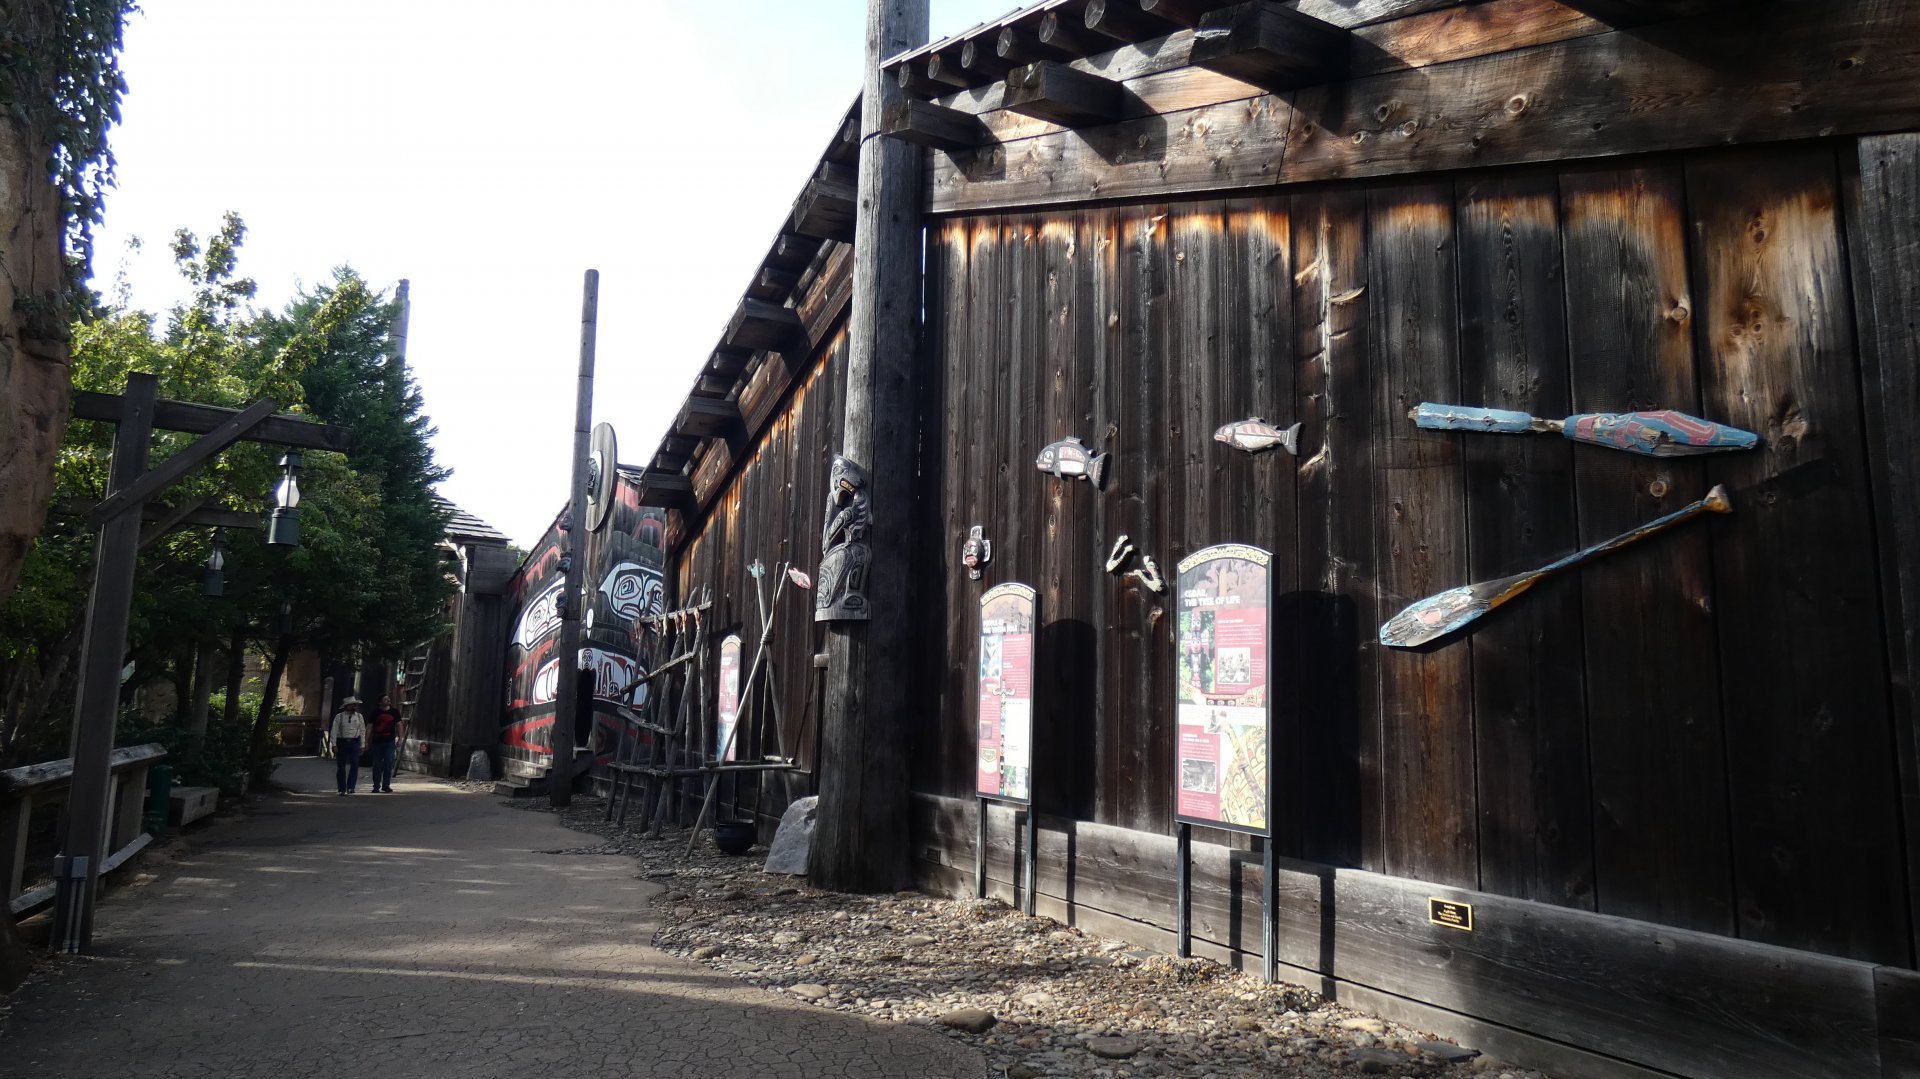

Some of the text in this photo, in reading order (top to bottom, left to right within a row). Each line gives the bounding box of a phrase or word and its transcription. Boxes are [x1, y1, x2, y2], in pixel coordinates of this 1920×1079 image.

[1185, 589, 1207, 598] CEDAR,
[1185, 595, 1240, 607] THE TREE OF LIFE
